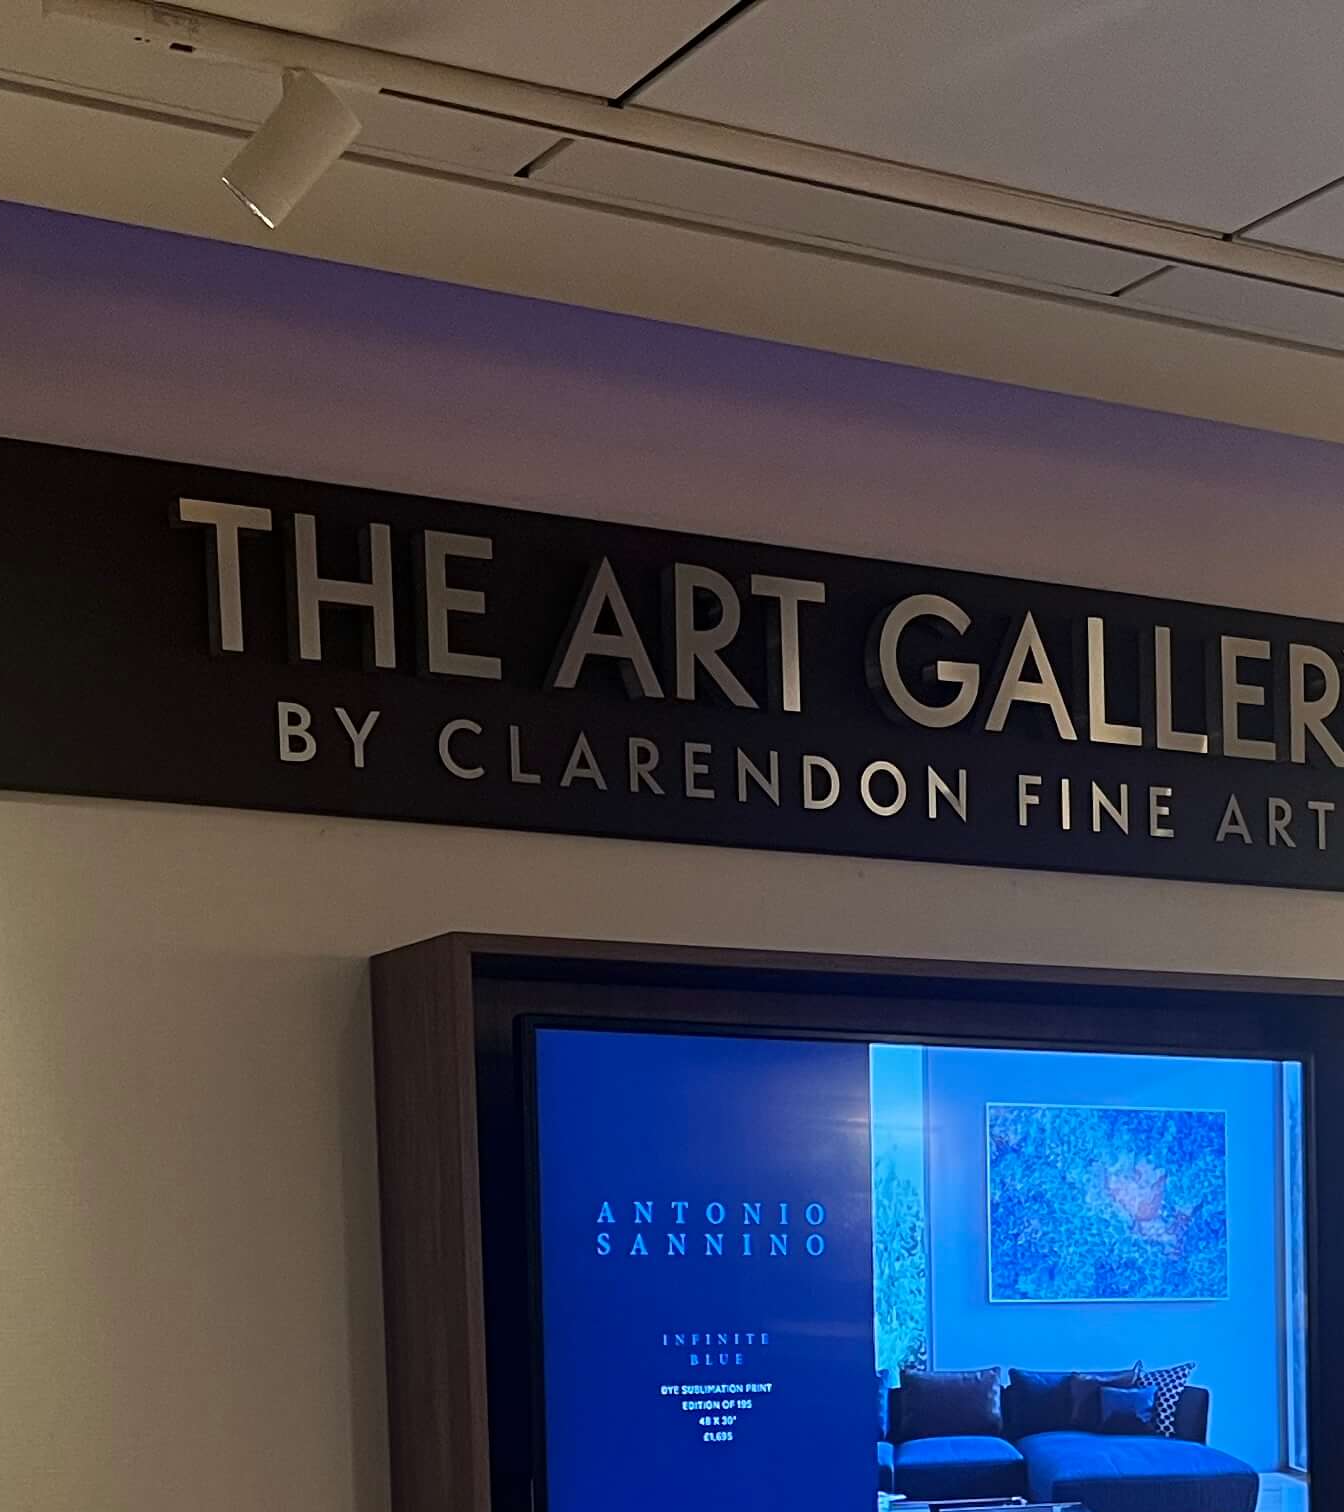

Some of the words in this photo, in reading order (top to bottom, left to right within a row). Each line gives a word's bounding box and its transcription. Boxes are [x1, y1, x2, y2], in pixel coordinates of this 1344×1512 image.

[179, 497, 502, 680] THE
[553, 556, 826, 713] ART
[277, 701, 380, 768] BY
[438, 719, 968, 823] CLARENDON
[1018, 774, 1175, 838] FINE
[1215, 794, 1336, 851] ART
[596, 1201, 825, 1225] ANTONIO
[596, 1232, 825, 1256] SANNINO
[663, 1333, 769, 1346] INFINITE
[690, 1353, 744, 1366] BLUE
[681, 1384, 744, 1395] SUBLIMATION
[745, 1383, 773, 1393] PRINT
[682, 1400, 721, 1411] EDITION
[721, 1400, 735, 1410] OF
